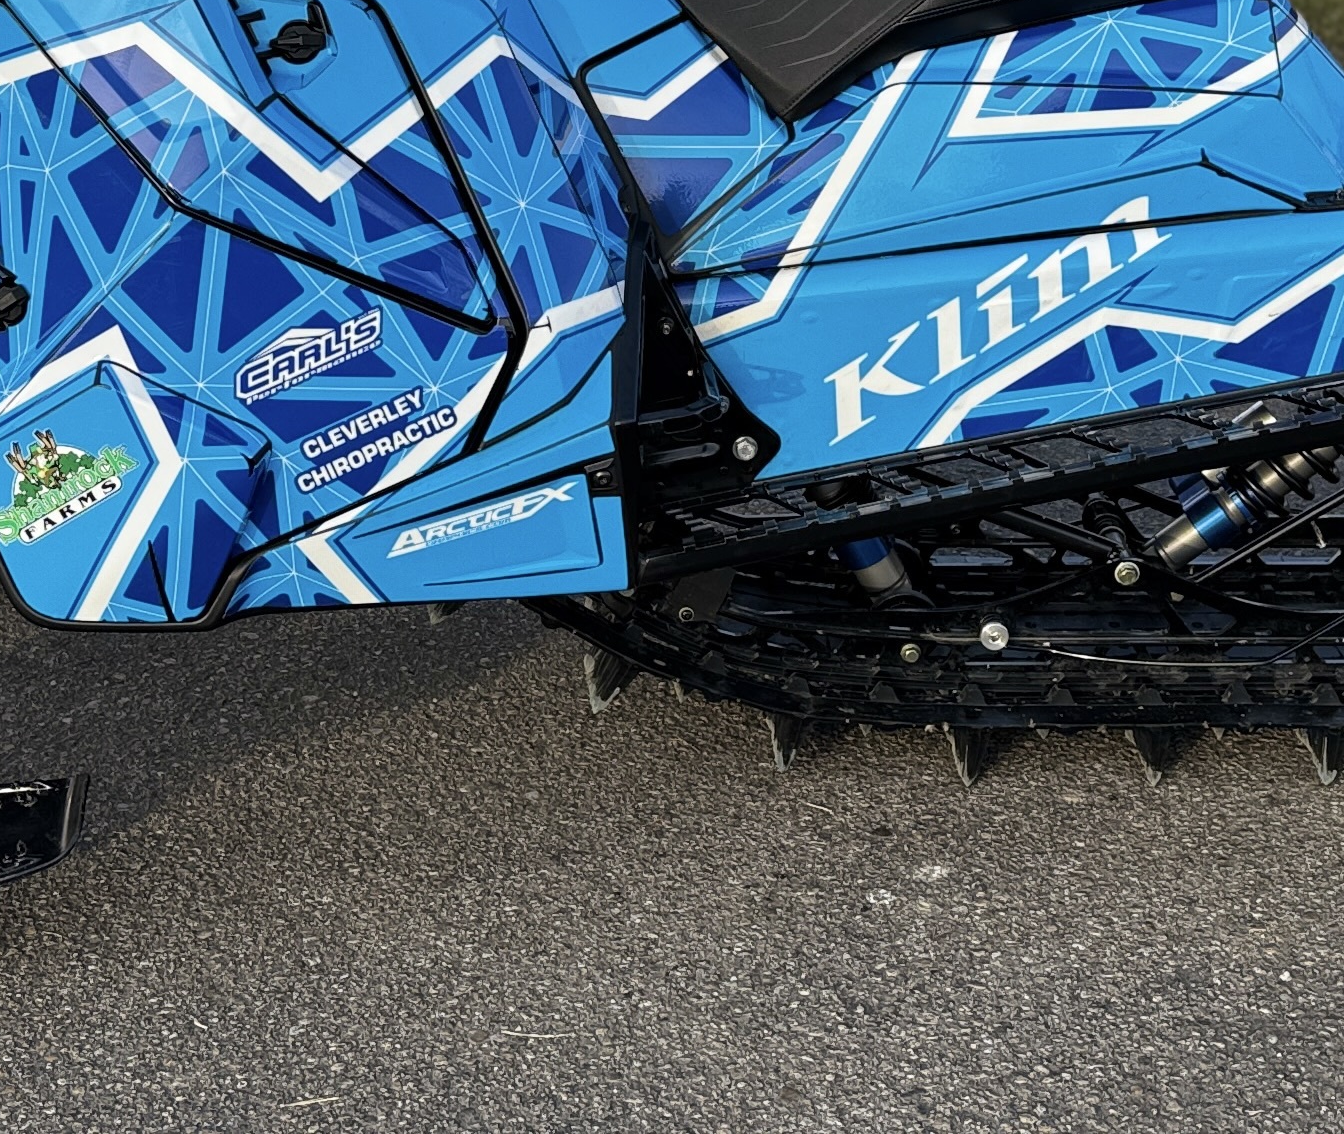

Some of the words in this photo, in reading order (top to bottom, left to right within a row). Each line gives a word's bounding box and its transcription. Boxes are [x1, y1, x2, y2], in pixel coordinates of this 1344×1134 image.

[237, 311, 380, 398] CARL'S
[297, 407, 455, 493] CHIROPRACTIC
[302, 388, 423, 459] CLEVERLEY
[24, 478, 118, 540] FARMS
